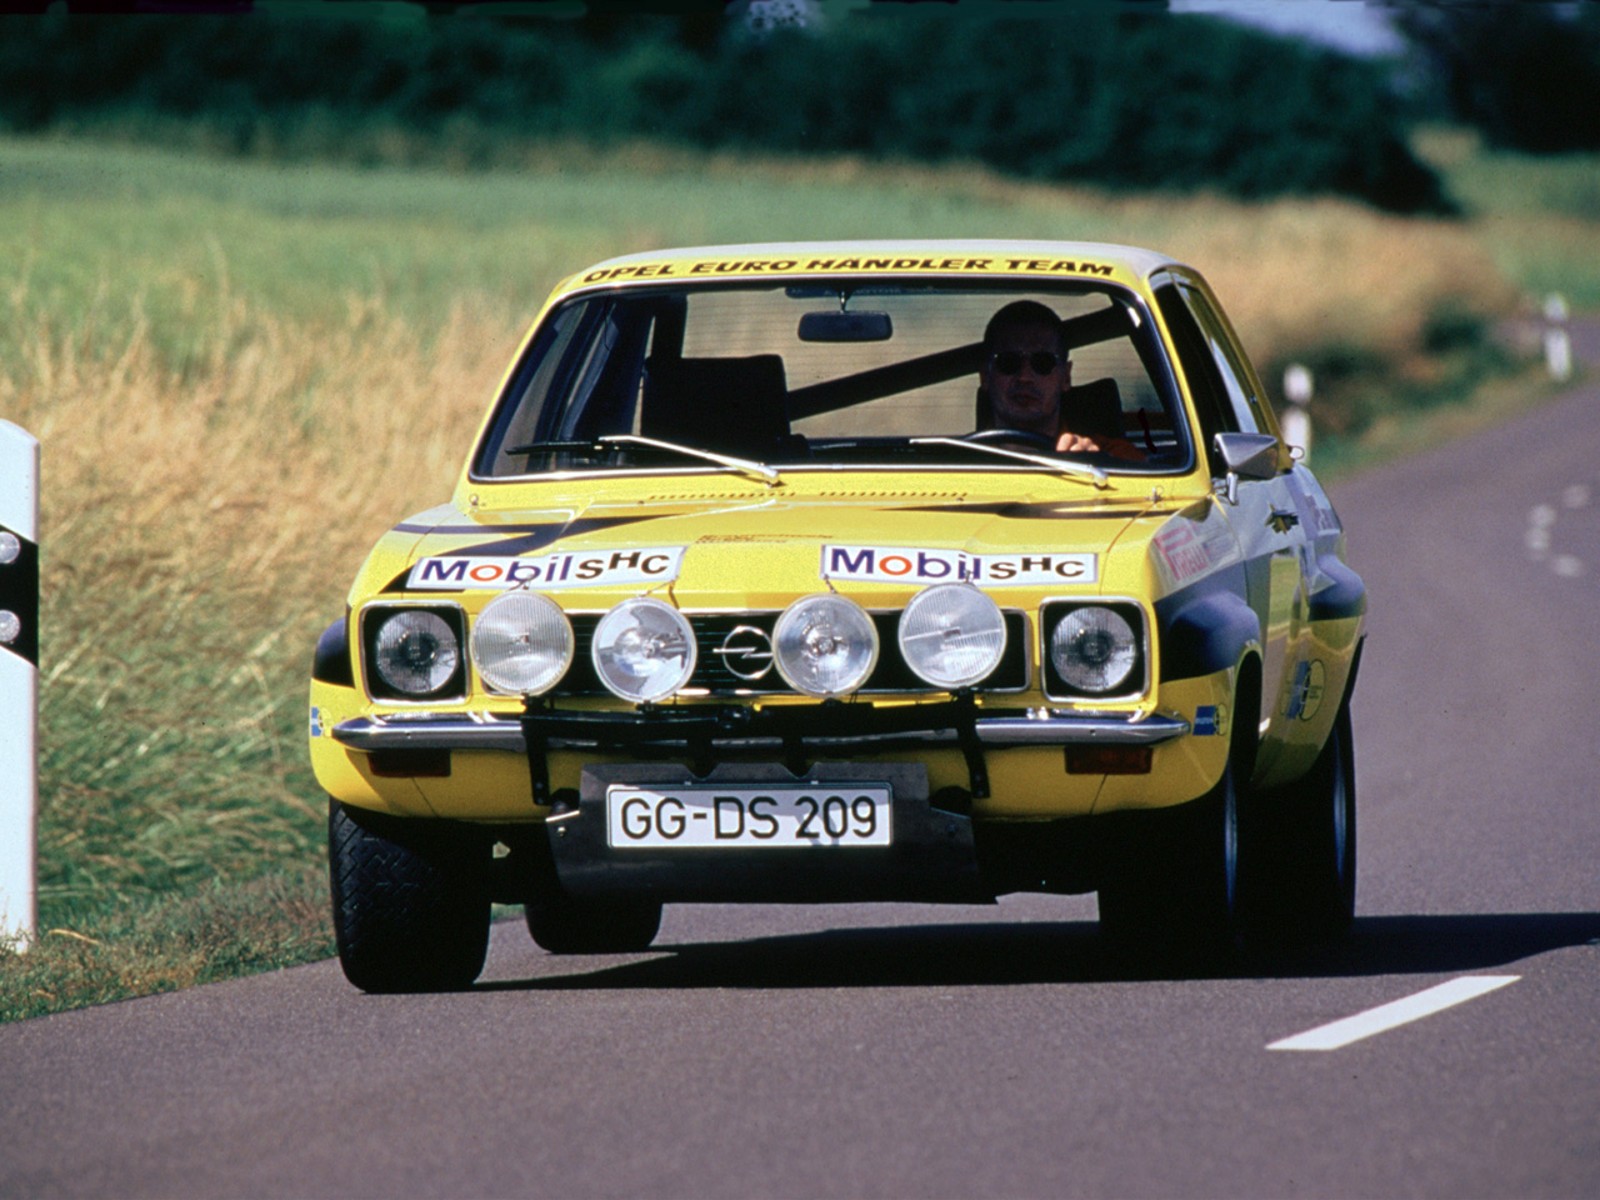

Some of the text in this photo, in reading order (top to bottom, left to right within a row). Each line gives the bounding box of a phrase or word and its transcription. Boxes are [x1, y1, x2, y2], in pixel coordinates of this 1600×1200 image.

[583, 264, 674, 283] OPEL
[690, 260, 797, 275] EURO
[1005, 259, 1114, 276] TEAM
[420, 555, 573, 582] Mobil
[830, 548, 981, 580] Mobil
[620, 795, 877, 839] GG-DS 209
